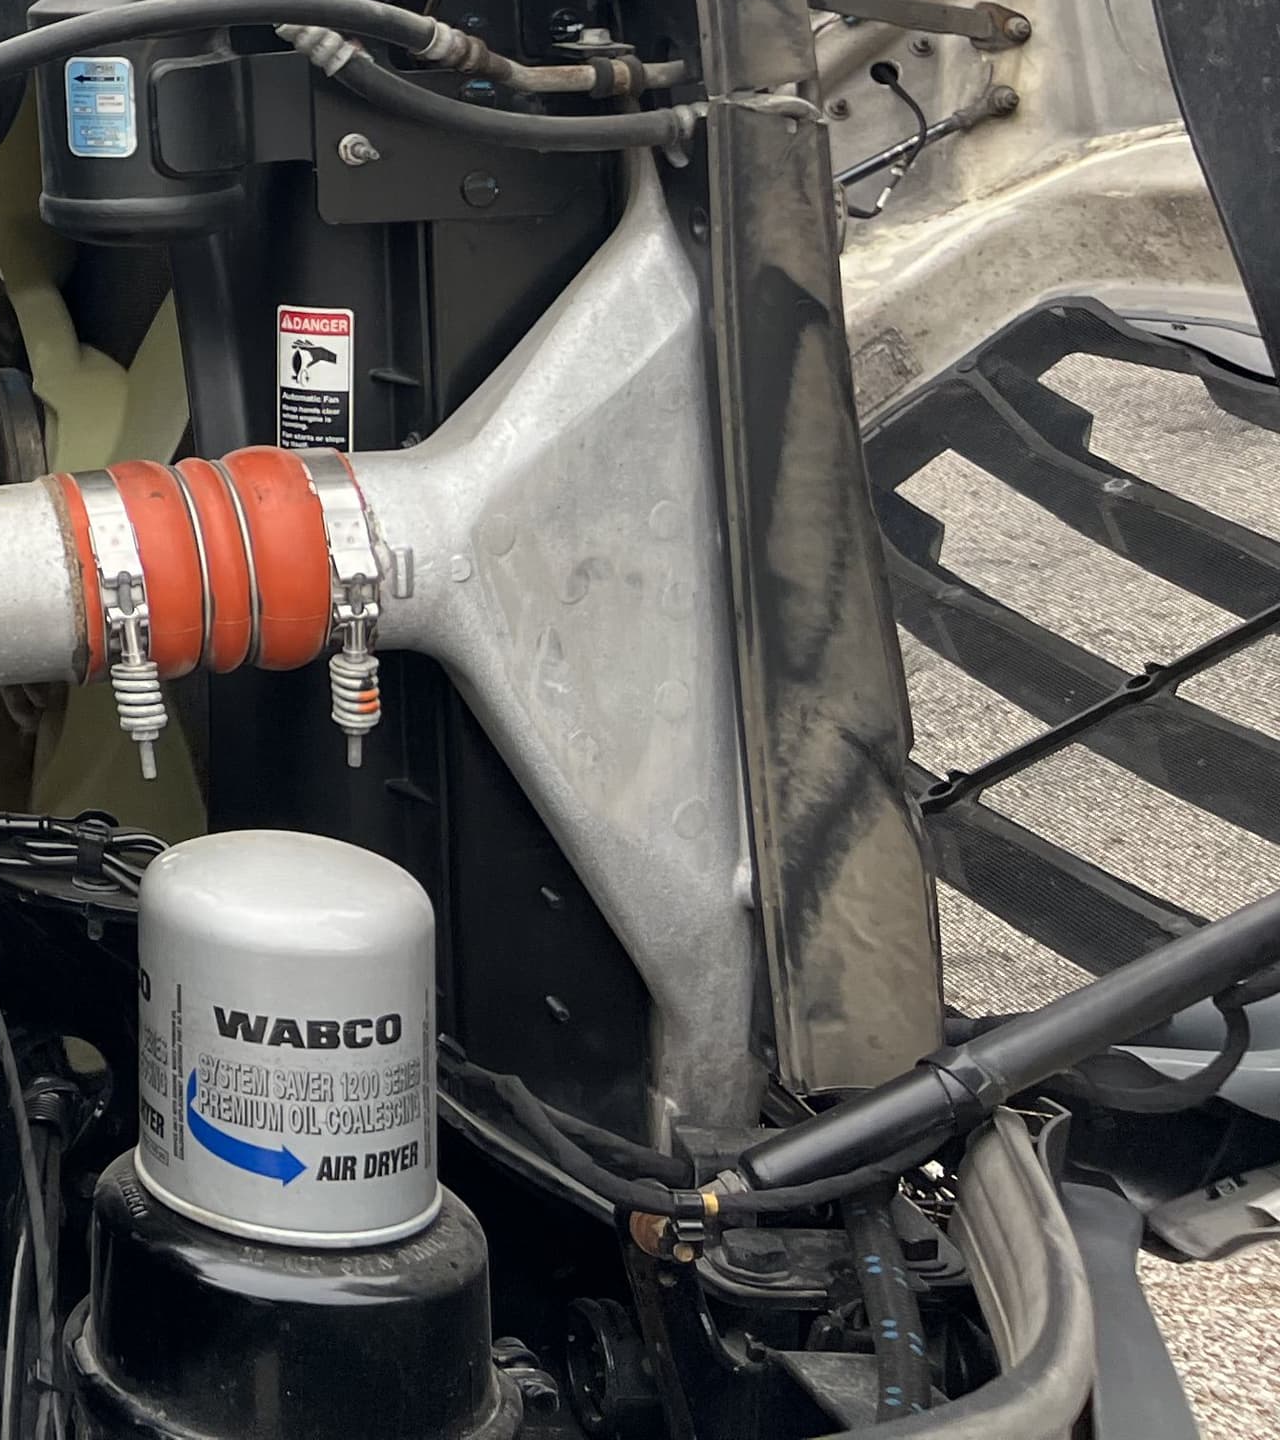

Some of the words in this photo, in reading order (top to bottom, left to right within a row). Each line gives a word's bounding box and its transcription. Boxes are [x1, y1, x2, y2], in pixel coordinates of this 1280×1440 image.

[293, 316, 349, 333] DANGER
[323, 395, 339, 403] Fan
[213, 1005, 402, 1050] WABCO
[198, 1052, 270, 1098] SYSTEM
[272, 1069, 334, 1103] SAVER
[340, 1071, 380, 1103] 1200
[383, 1057, 421, 1097] SERIES
[198, 1086, 284, 1133] PREMIUM
[291, 1103, 322, 1135] OIL
[326, 1091, 422, 1136] COALESCING
[316, 1155, 357, 1181] AIR
[363, 1140, 419, 1180] DRYER
